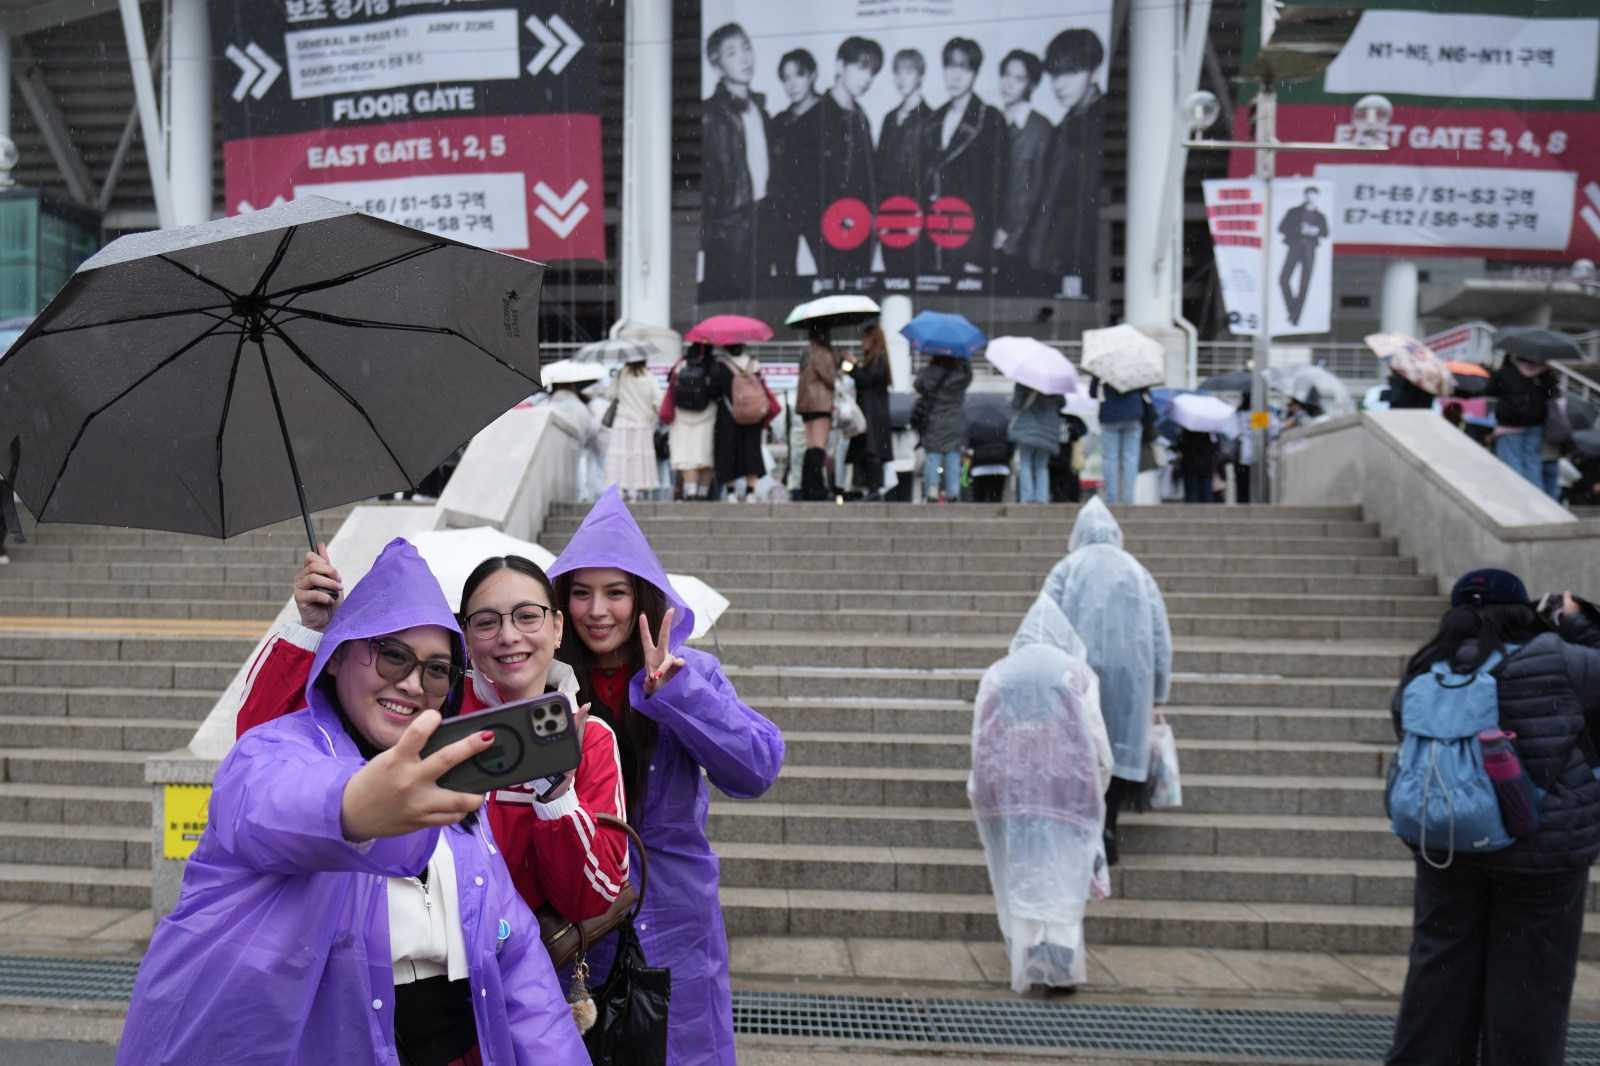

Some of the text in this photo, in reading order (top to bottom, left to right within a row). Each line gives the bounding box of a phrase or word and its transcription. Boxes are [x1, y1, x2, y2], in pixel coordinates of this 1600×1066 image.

[332, 87, 476, 121] FLOOR GATE
[307, 134, 507, 169] EAST GATE 1, 2, 5
[1408, 125, 1483, 150] GATE
[1488, 128, 1512, 156] 3,
[1517, 130, 1541, 157] 4,
[457, 191, 486, 211] 구역
[1501, 187, 1535, 208] 구역
[464, 214, 494, 232] 구역
[1503, 212, 1539, 232] 구역
